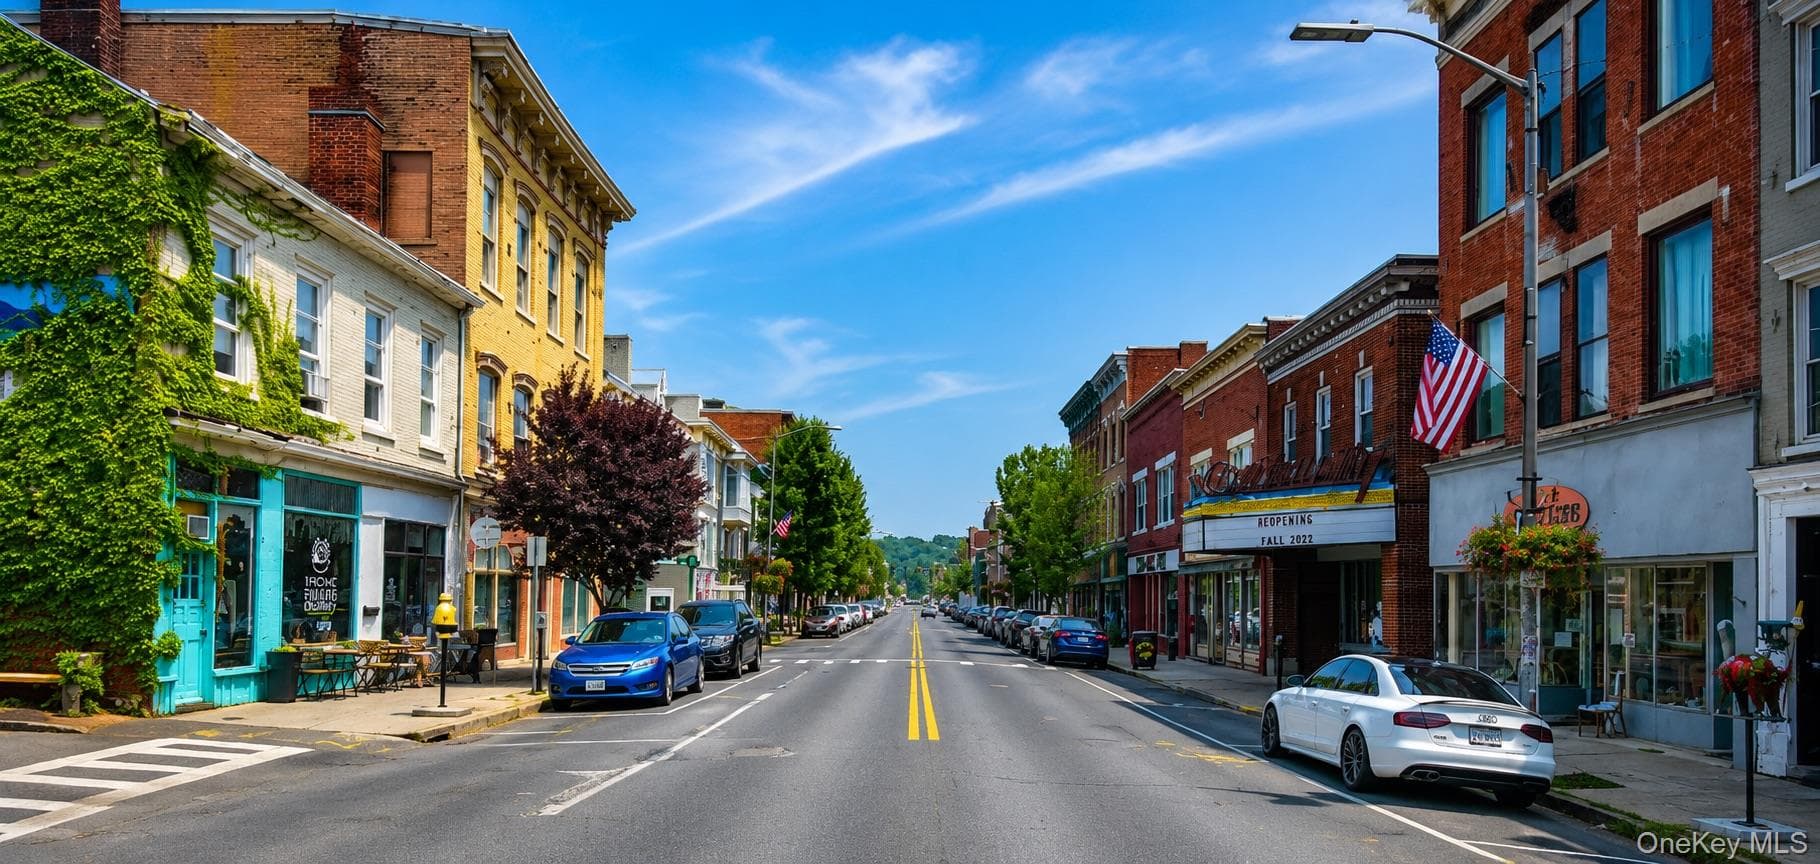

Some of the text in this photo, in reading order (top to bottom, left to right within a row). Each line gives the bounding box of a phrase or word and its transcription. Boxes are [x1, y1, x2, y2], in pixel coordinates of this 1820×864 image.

[1257, 513, 1313, 528] REOPENING
[1261, 534, 1313, 546] FALL 2022
